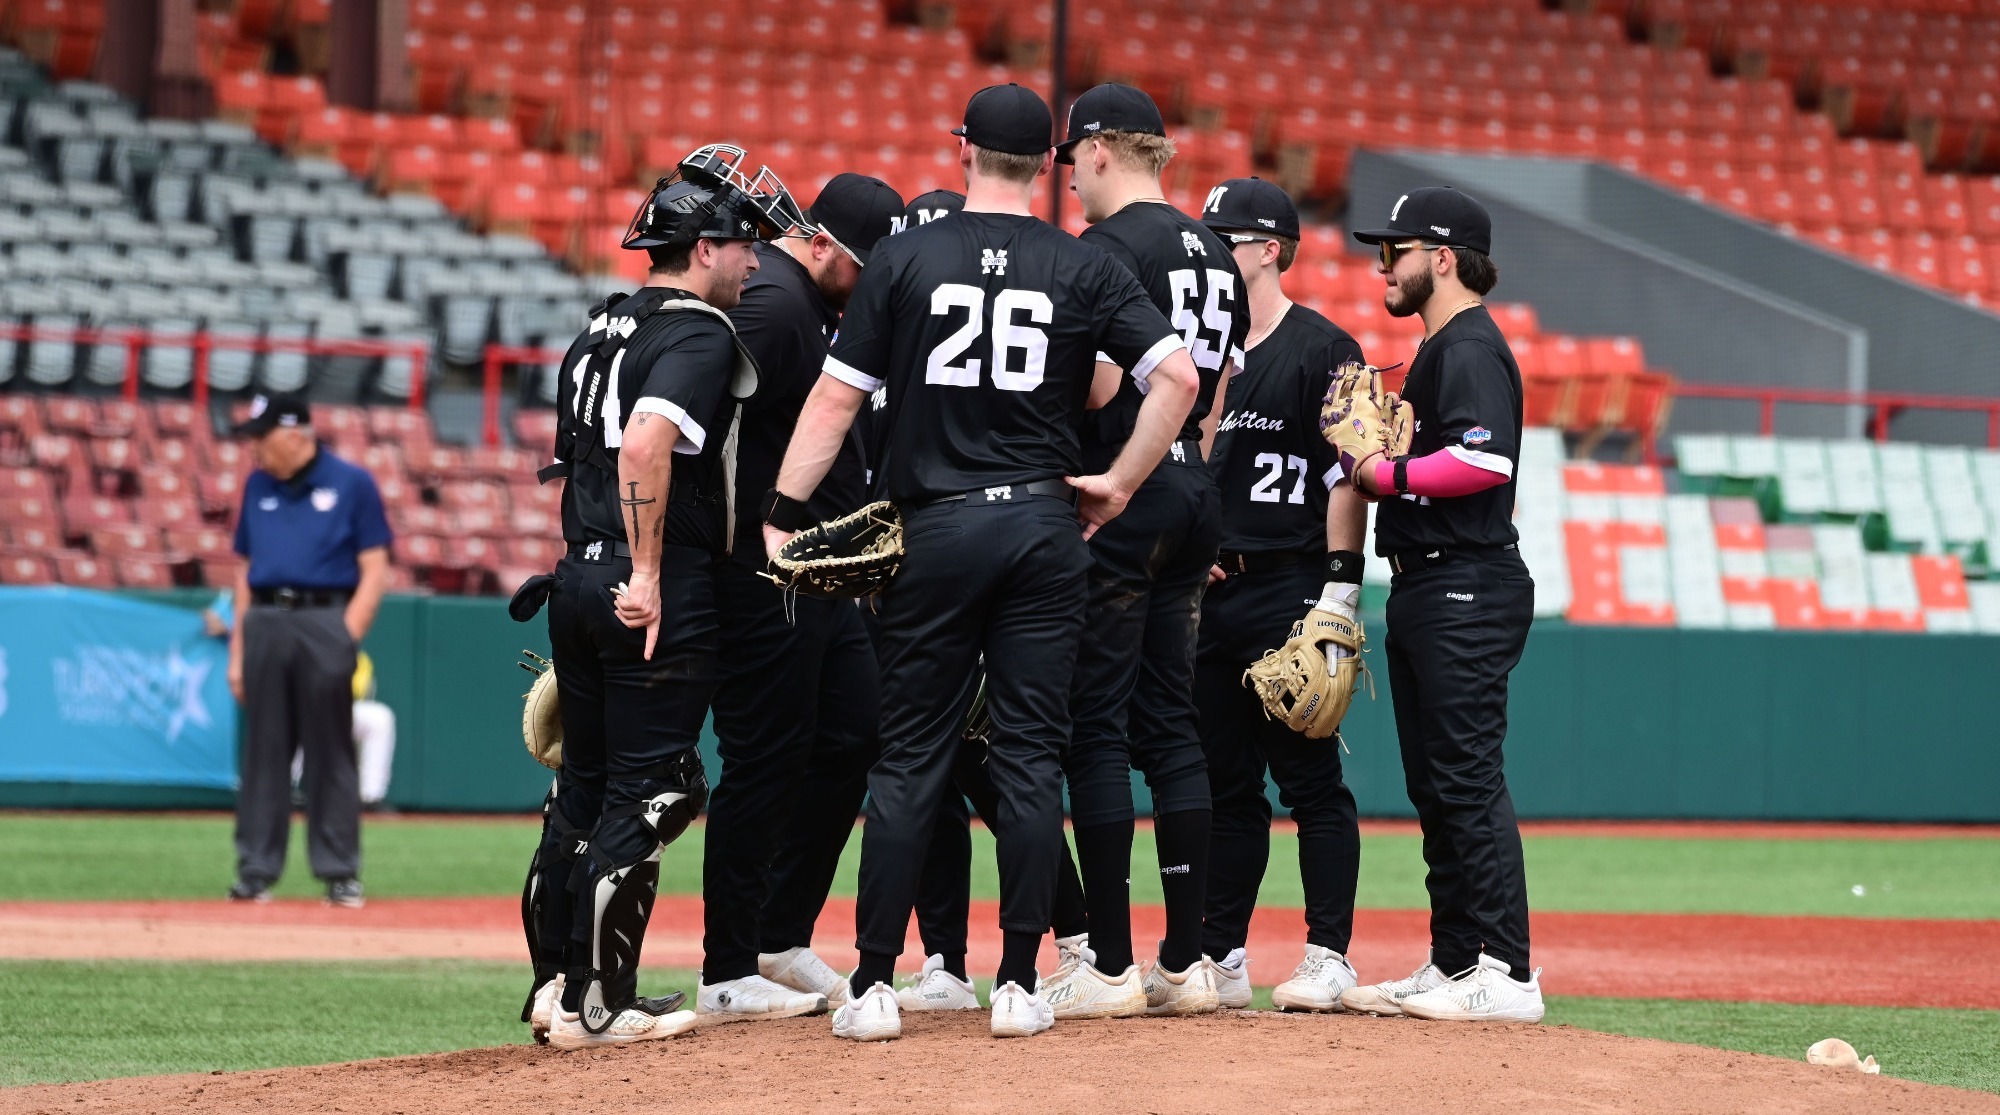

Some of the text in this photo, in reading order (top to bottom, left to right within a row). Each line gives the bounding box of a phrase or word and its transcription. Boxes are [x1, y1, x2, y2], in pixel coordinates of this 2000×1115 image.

[925, 283, 1054, 392] 26
[1168, 268, 1235, 371] 55
[583, 371, 601, 427] marucci
[1250, 452, 1308, 505] 27
[1317, 620, 1352, 637] Wilson
[588, 1005, 604, 1020] m
